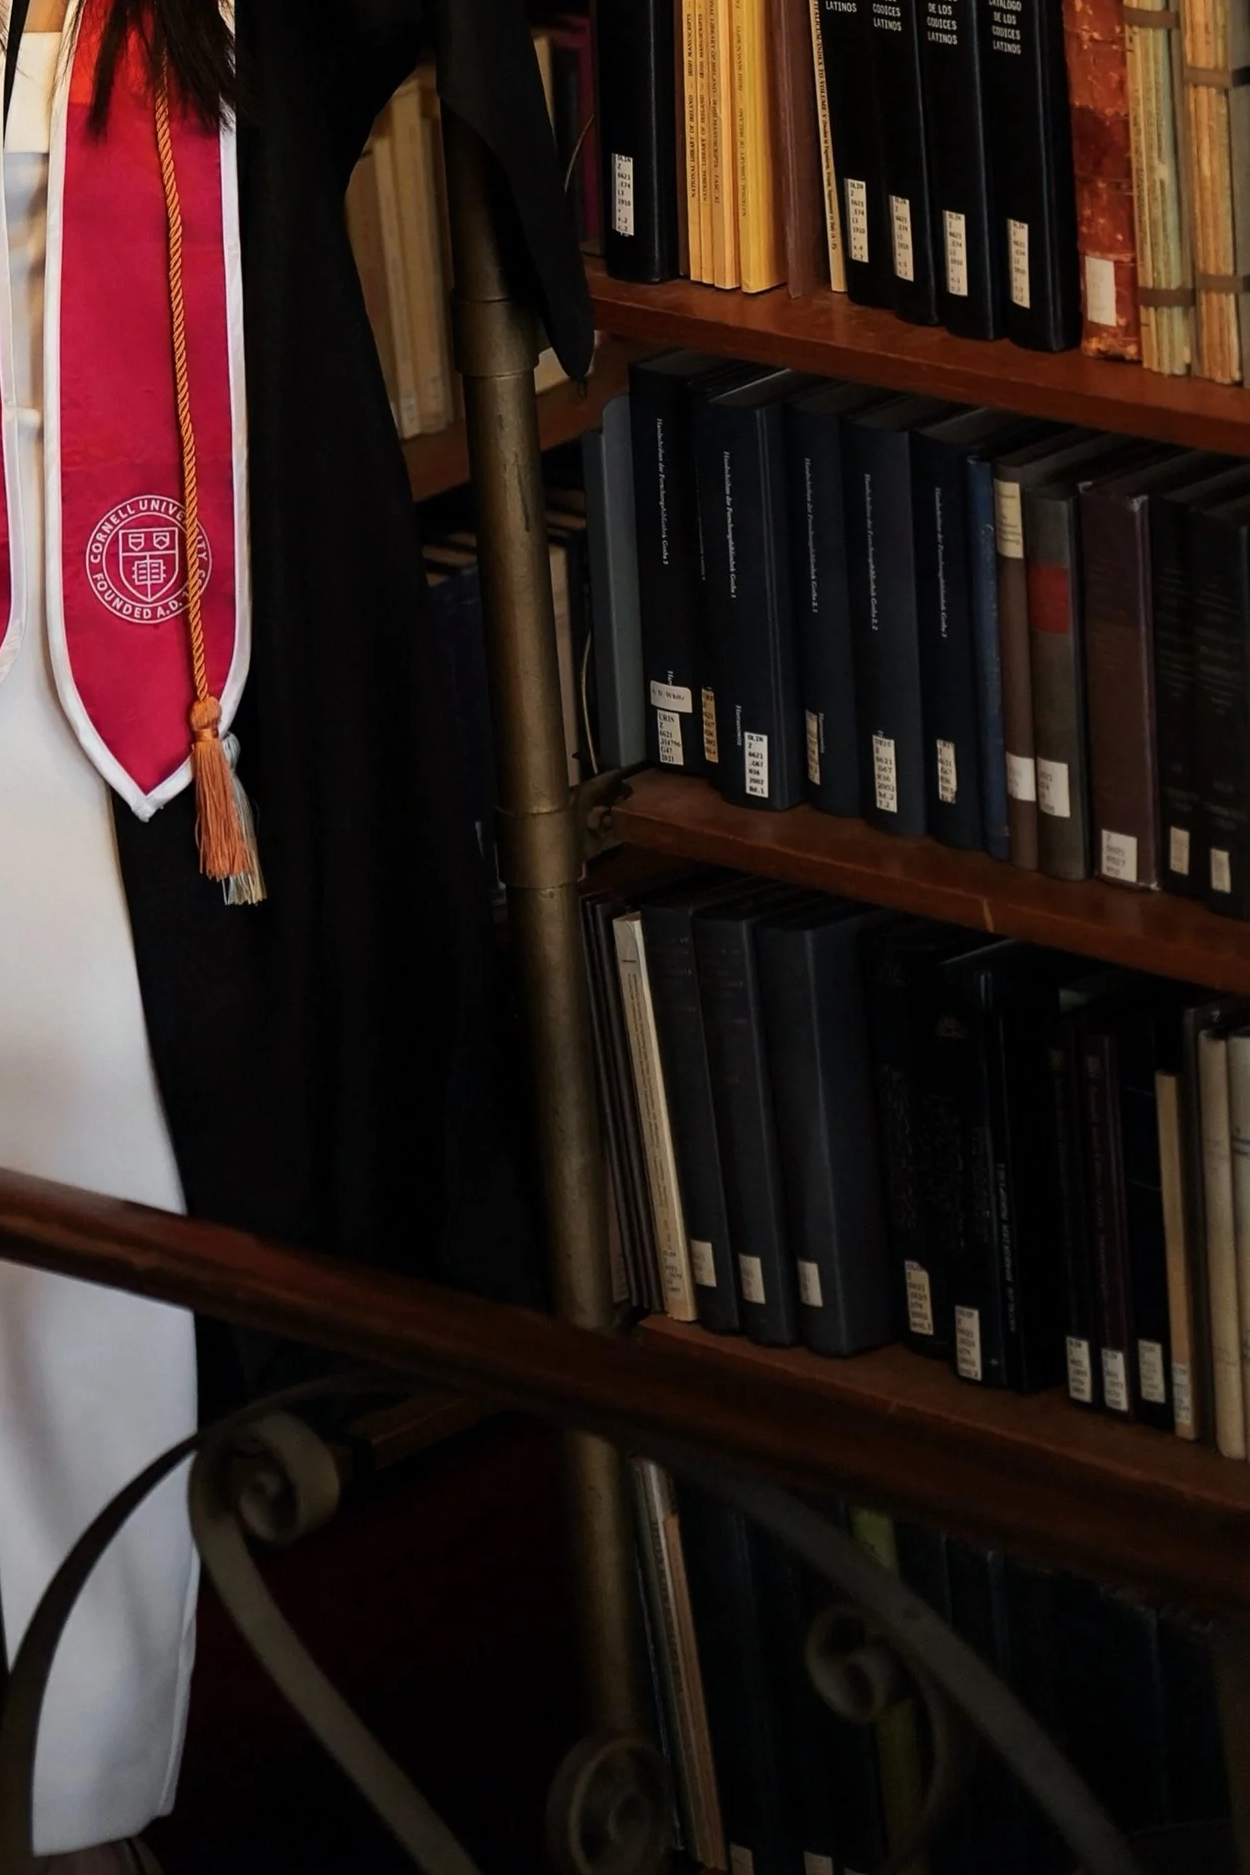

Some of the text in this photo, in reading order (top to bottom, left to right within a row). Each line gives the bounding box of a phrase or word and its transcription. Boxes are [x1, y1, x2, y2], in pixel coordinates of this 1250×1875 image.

[826, 1, 857, 13] LATINOS
[873, 3, 901, 17] CODICES
[929, 2, 952, 15] DE LOS
[874, 18, 901, 31] LATINOS
[927, 16, 957, 30] CODICES
[994, 12, 1016, 25] DE LOS
[928, 31, 957, 45] LATINOS
[992, 25, 1021, 40] CODICES
[993, 40, 1021, 55] LATINOS
[90, 504, 136, 564] CORNELL
[92, 572, 151, 619] FOUNDED
